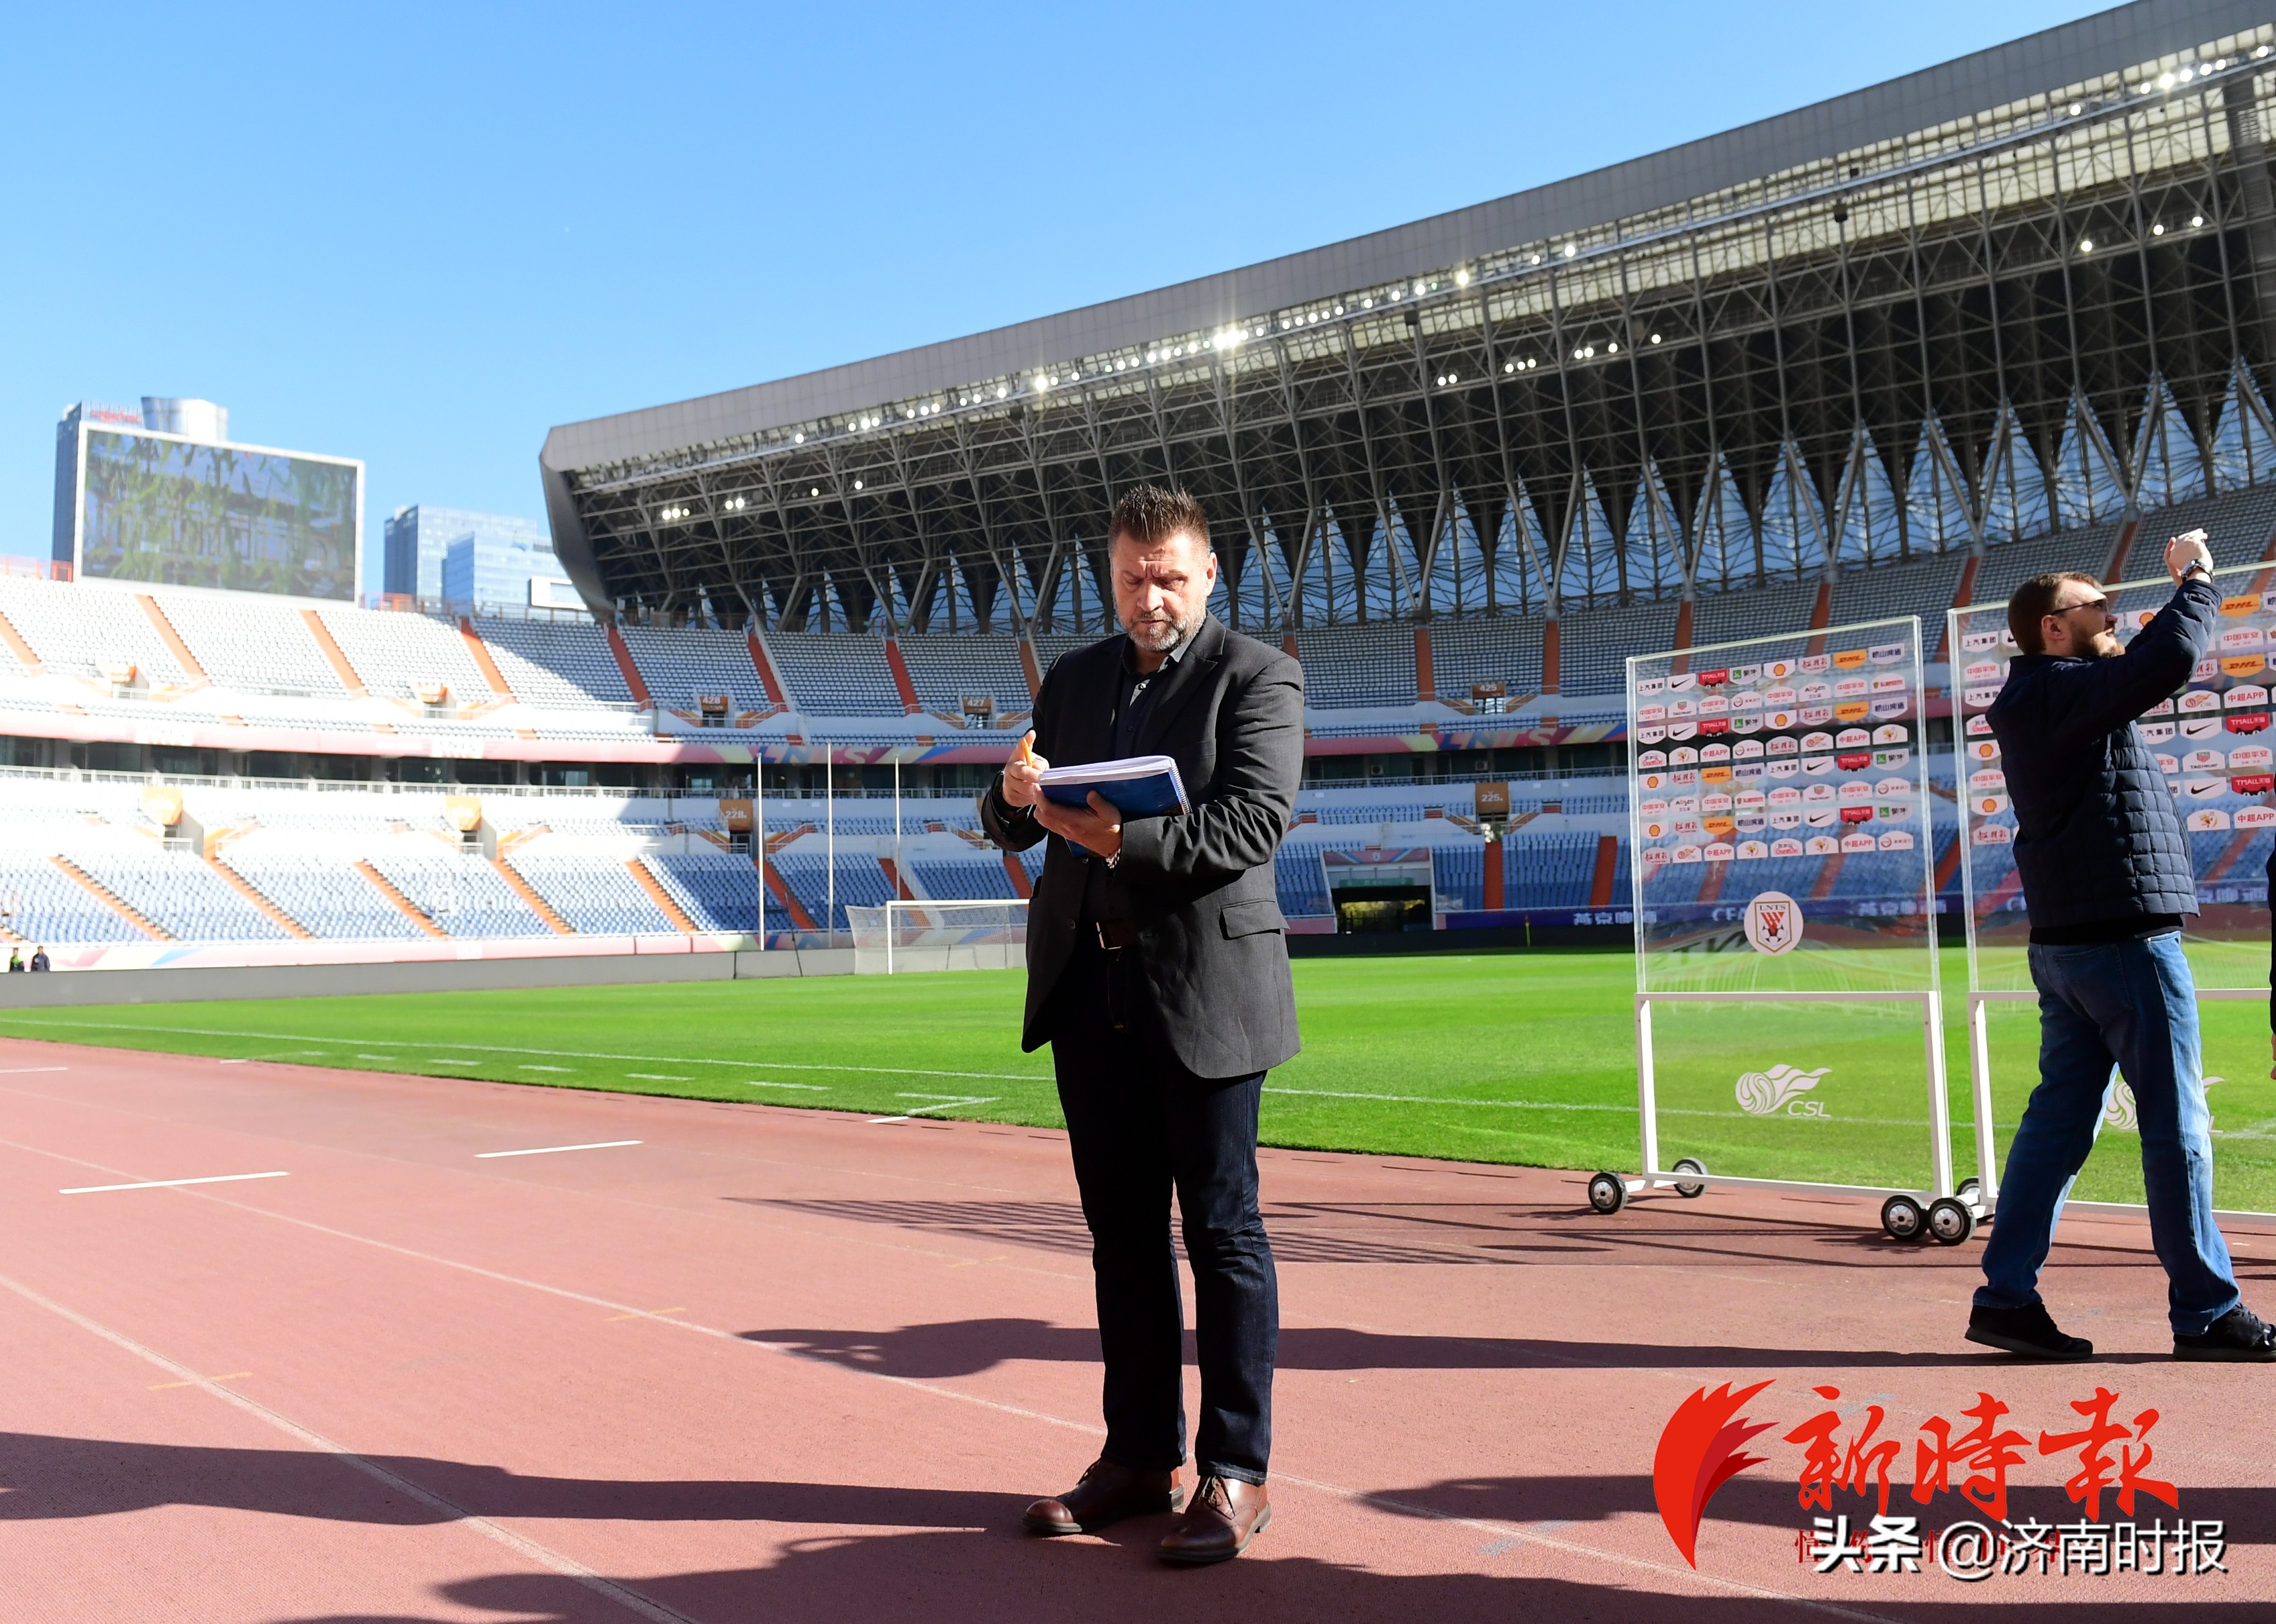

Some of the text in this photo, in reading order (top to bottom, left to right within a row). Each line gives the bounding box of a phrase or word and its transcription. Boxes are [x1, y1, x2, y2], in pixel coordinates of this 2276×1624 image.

[2224, 631, 2259, 642] 中国平安
[1965, 637, 1996, 647] 上汽集团
[1967, 665, 1996, 674] 中国平安
[2228, 692, 2264, 702] 中超APP
[2232, 750, 2268, 759] 中国平安
[2238, 813, 2275, 823] 中超APP
[1788, 1100, 1831, 1117] CSL
